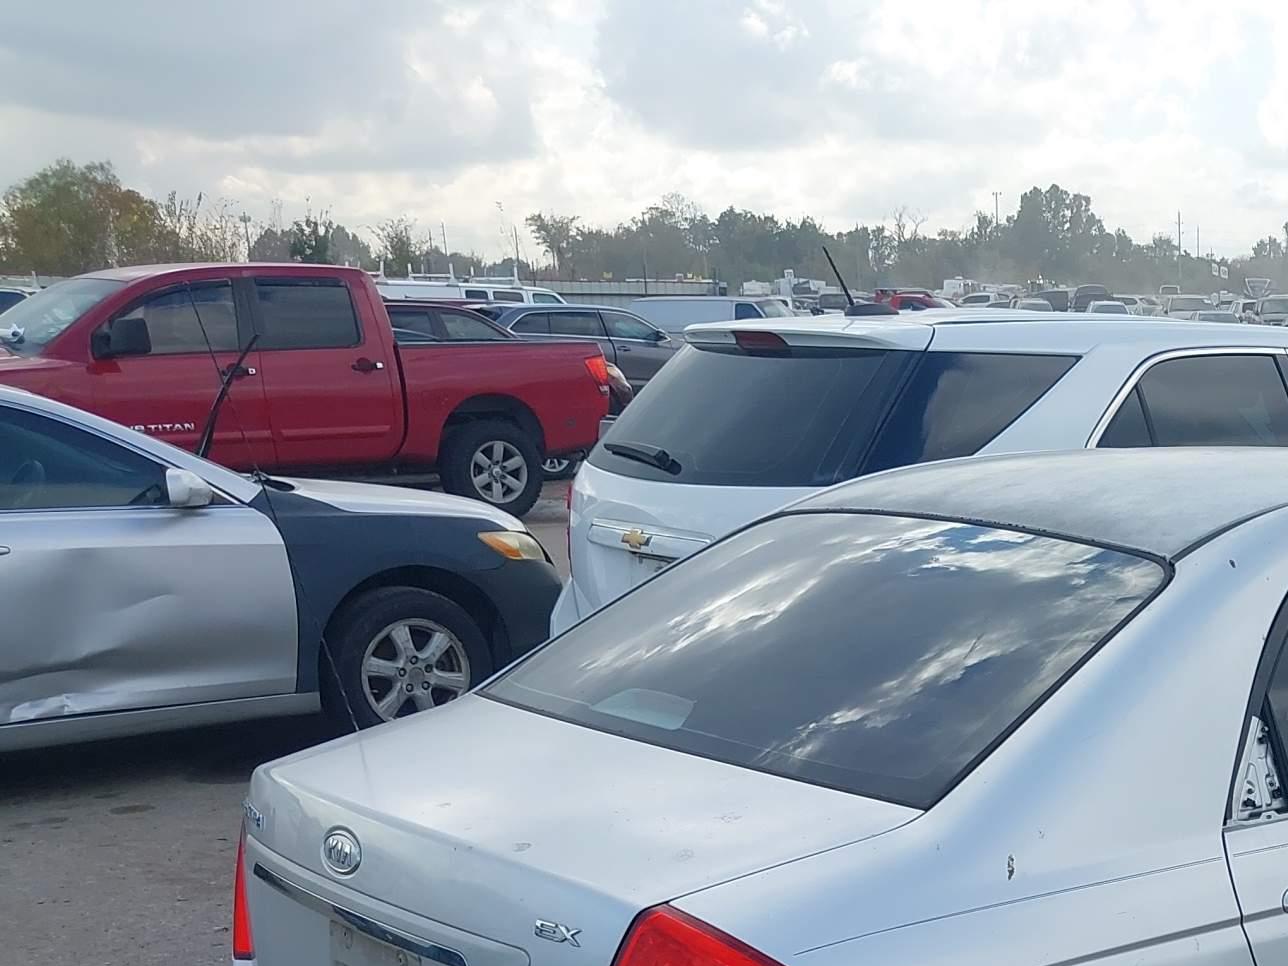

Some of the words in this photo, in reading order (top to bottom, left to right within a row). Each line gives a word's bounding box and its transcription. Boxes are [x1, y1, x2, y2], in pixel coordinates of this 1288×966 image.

[147, 422, 195, 432] TITAN
[328, 837, 352, 867] KIA
[535, 919, 582, 948] EX
